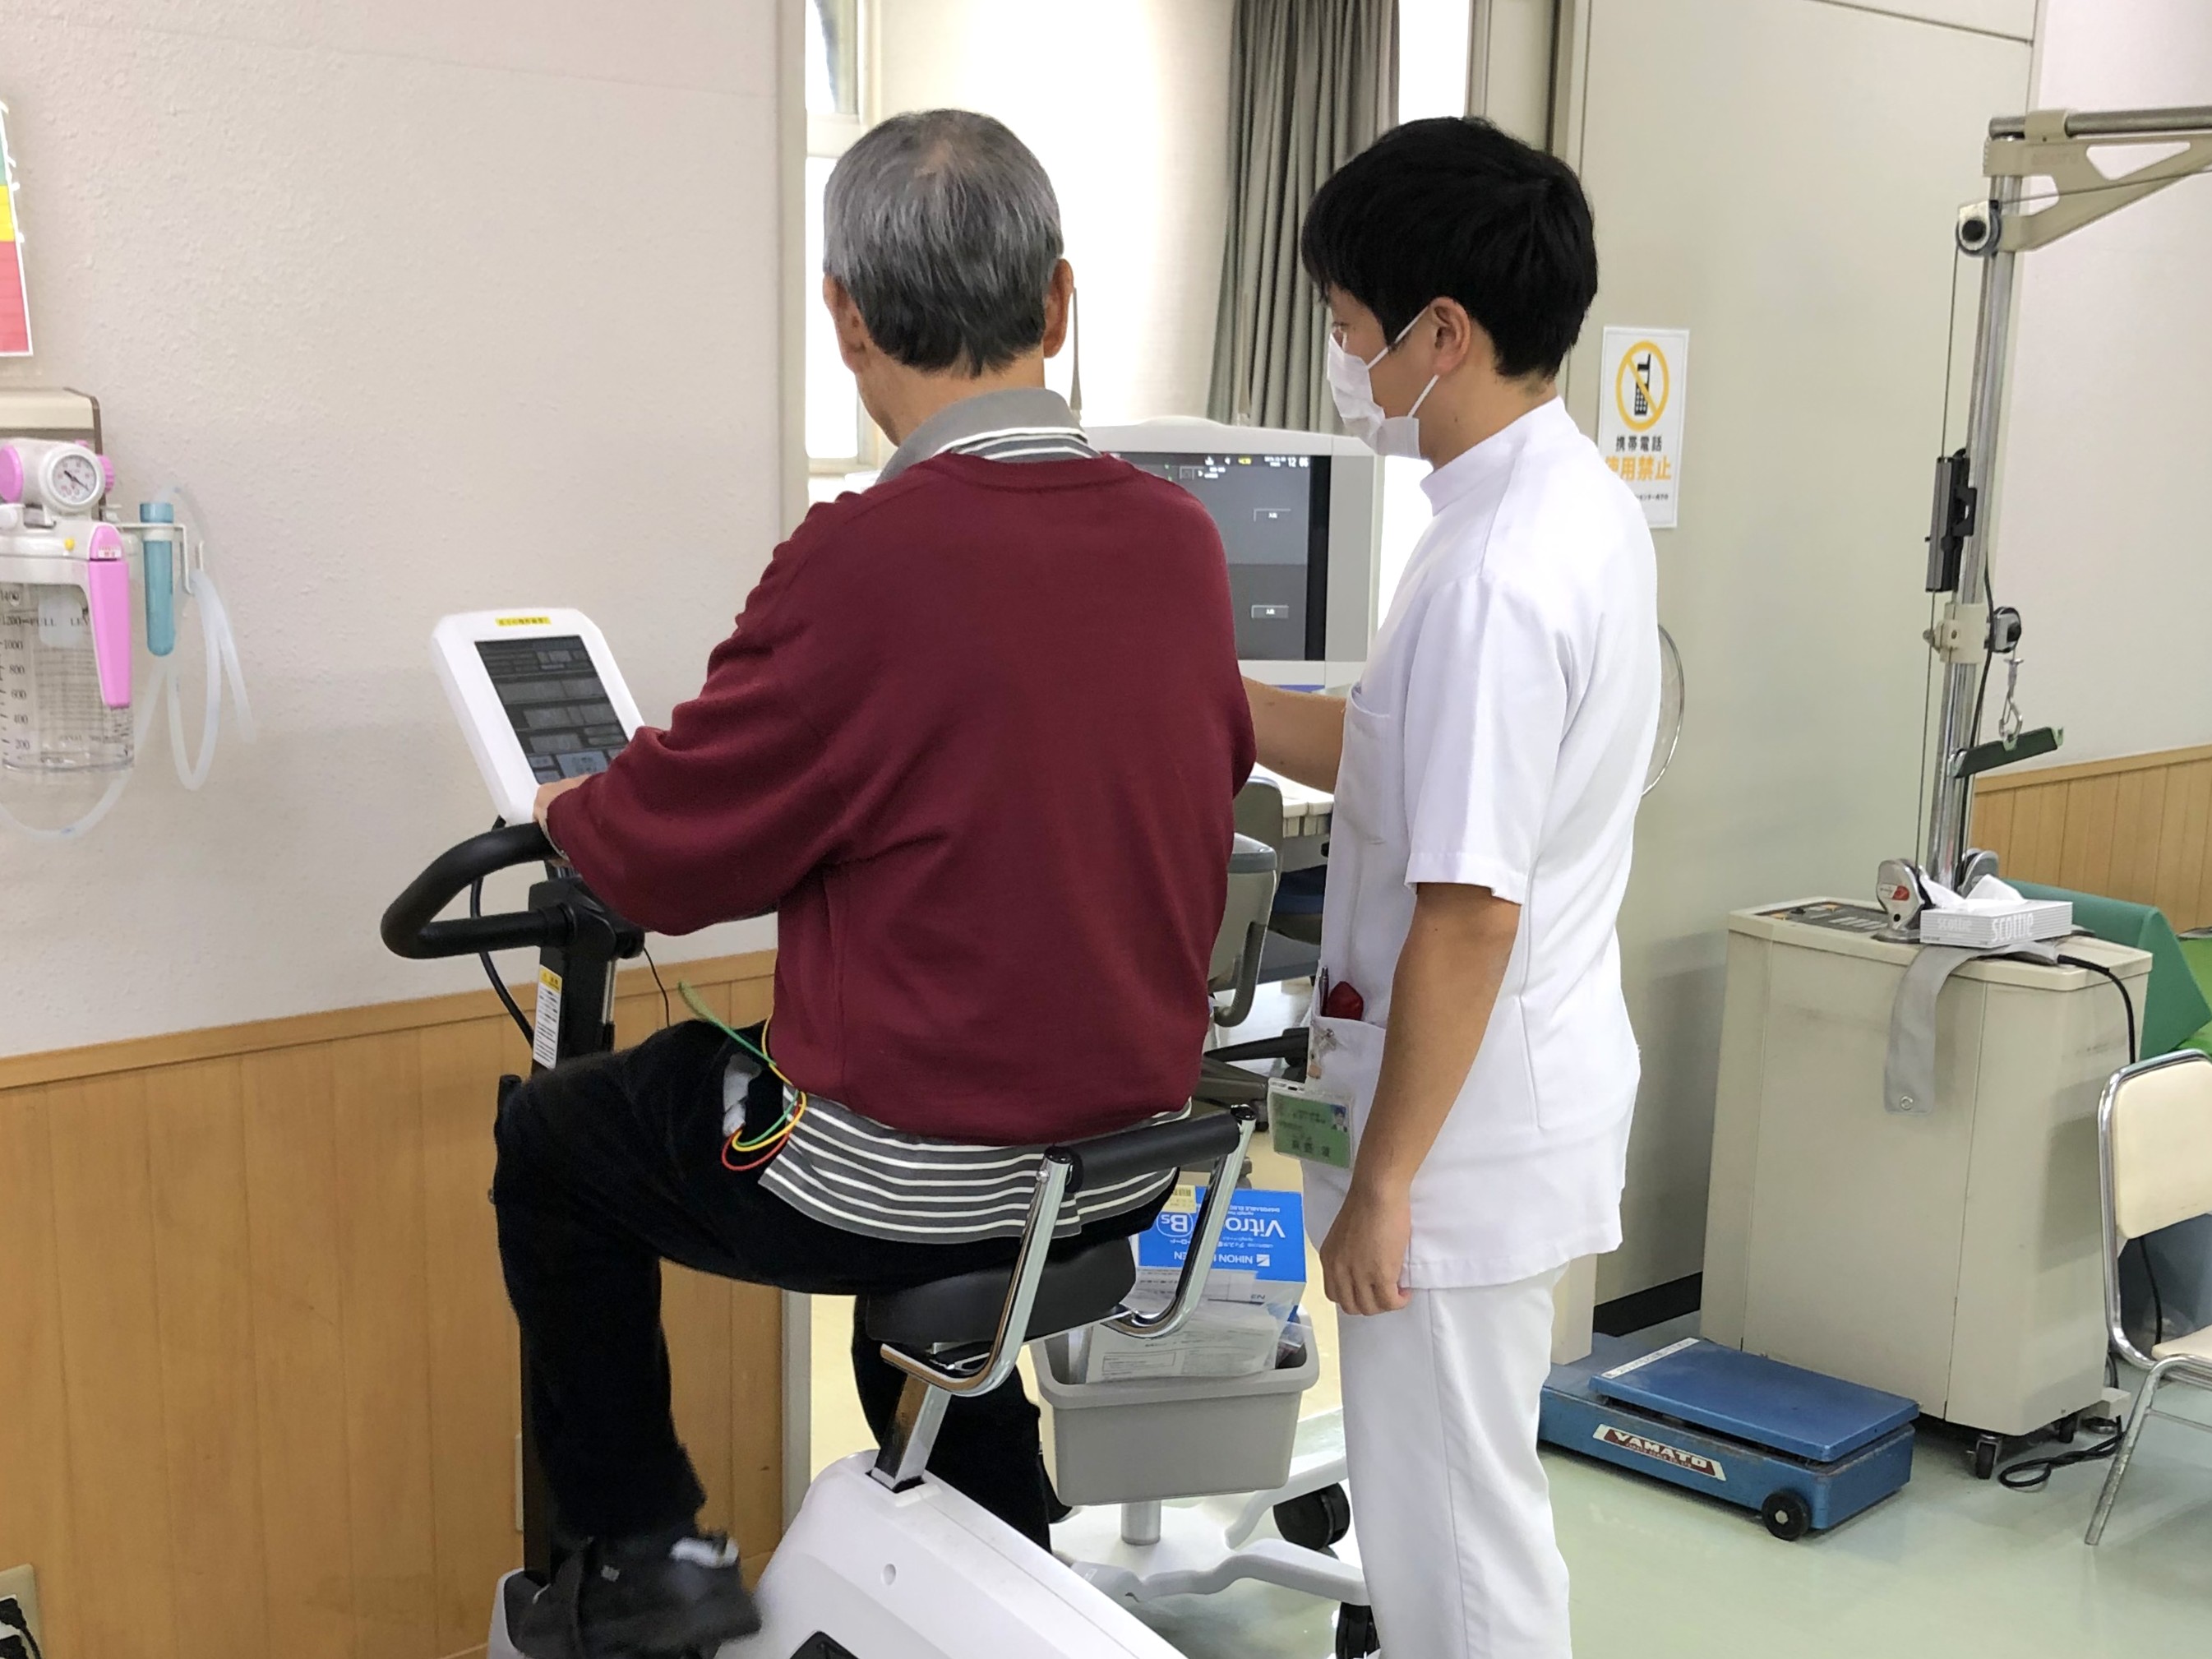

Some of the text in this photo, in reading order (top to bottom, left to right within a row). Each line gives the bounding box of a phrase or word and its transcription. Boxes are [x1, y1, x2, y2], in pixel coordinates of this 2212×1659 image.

[1615, 436, 1662, 452] 携帯電話
[70, 617, 89, 626] LEV
[3, 641, 23, 650] 1000
[9, 666, 25, 675] 800
[11, 690, 26, 699] 600
[13, 714, 28, 724] 400
[15, 740, 30, 750] 200
[1161, 1214, 1286, 1238] Vitro Bs
[1218, 1254, 1253, 1264] NIHON
[1614, 1431, 1708, 1468] YAMATO
